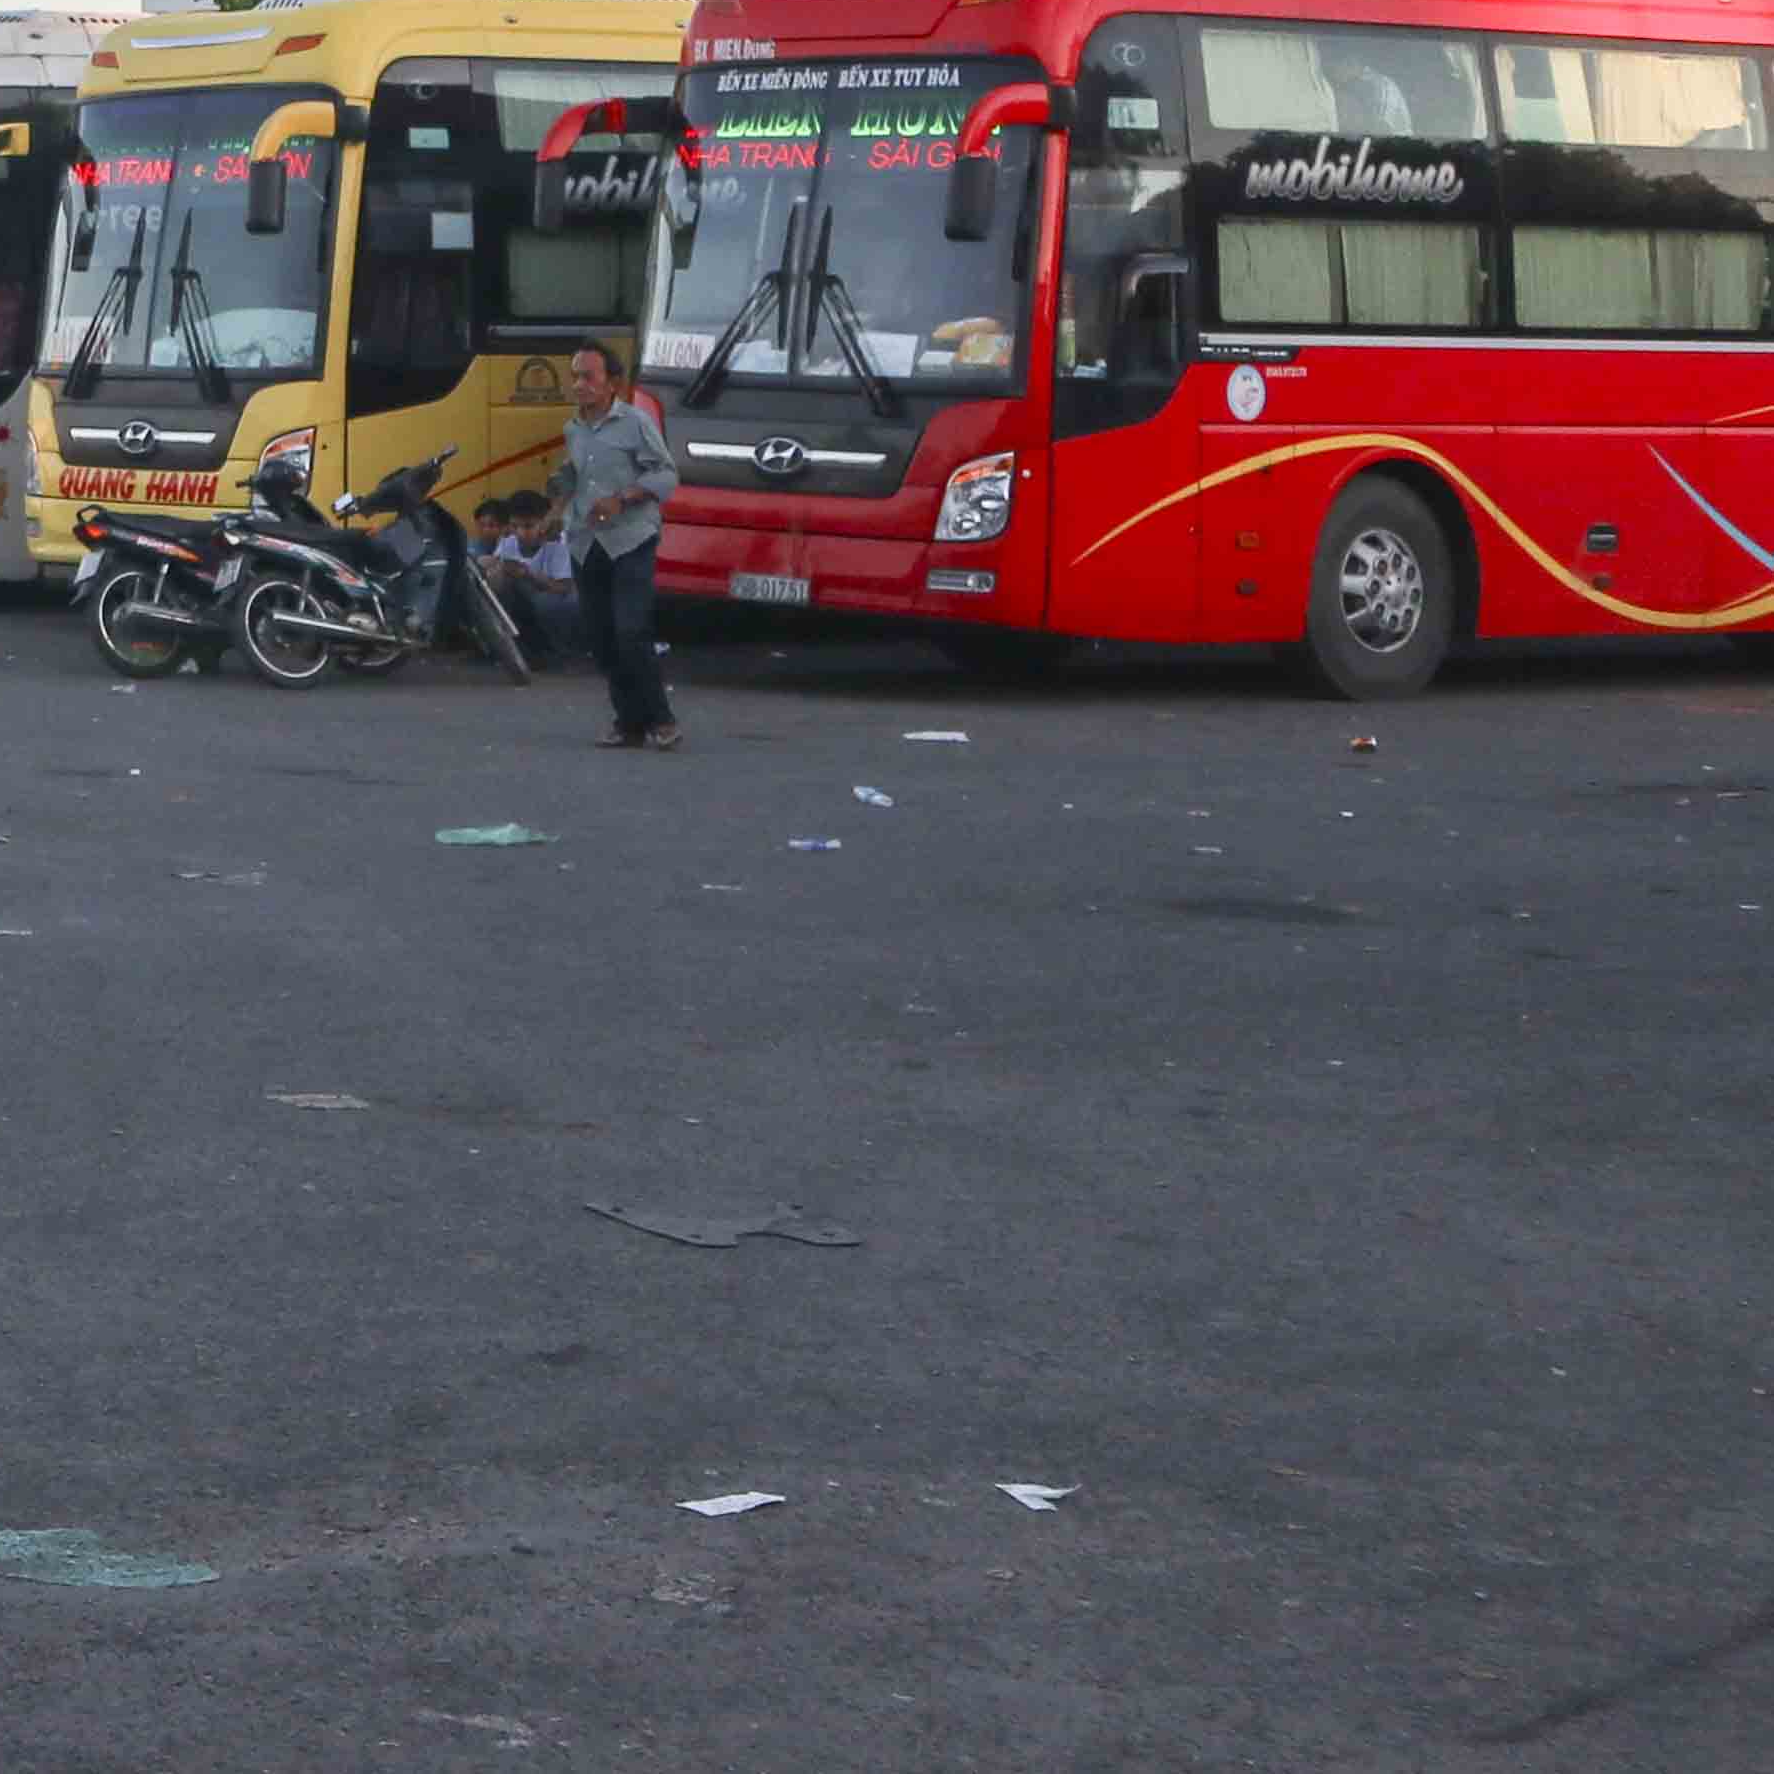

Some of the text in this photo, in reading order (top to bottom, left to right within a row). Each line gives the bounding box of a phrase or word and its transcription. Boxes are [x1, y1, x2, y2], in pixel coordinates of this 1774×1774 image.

[869, 68, 891, 86] XE
[895, 68, 926, 86] TUY
[1245, 134, 1464, 203] mobihome
